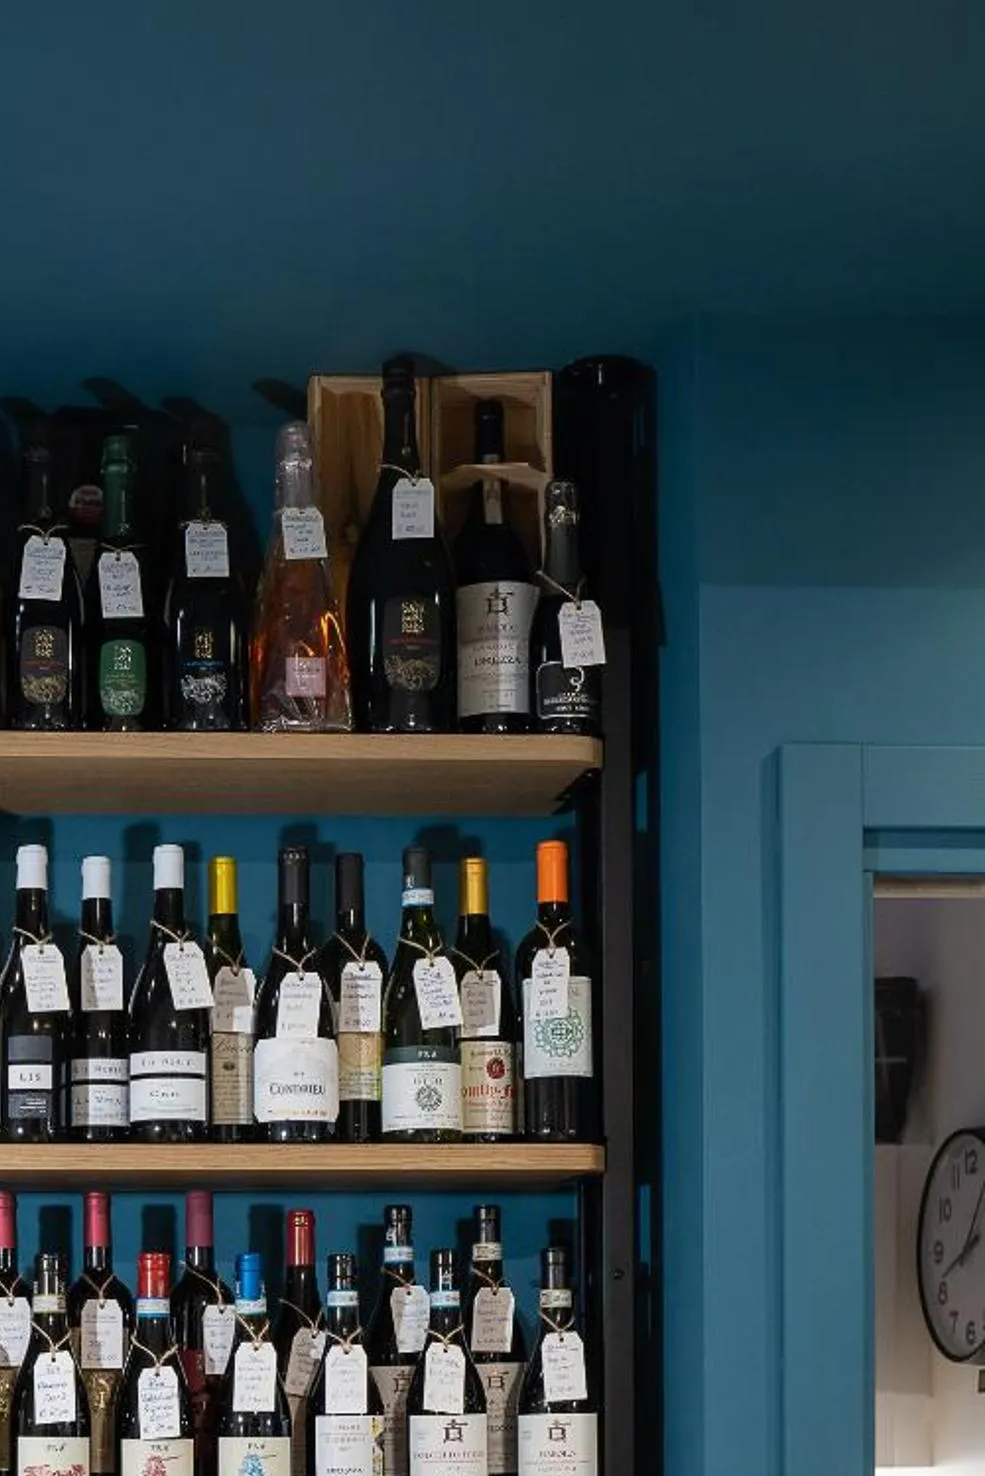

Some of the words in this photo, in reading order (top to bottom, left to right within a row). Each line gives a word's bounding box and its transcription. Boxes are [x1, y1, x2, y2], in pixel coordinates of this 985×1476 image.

[965, 1150, 979, 1175] 12
[952, 1165, 961, 1191] 11
[939, 1197, 953, 1224] 10
[933, 1240, 945, 1264] 9
[937, 1281, 949, 1305] 8
[949, 1311, 960, 1333] 7
[966, 1321, 977, 1344] 6
